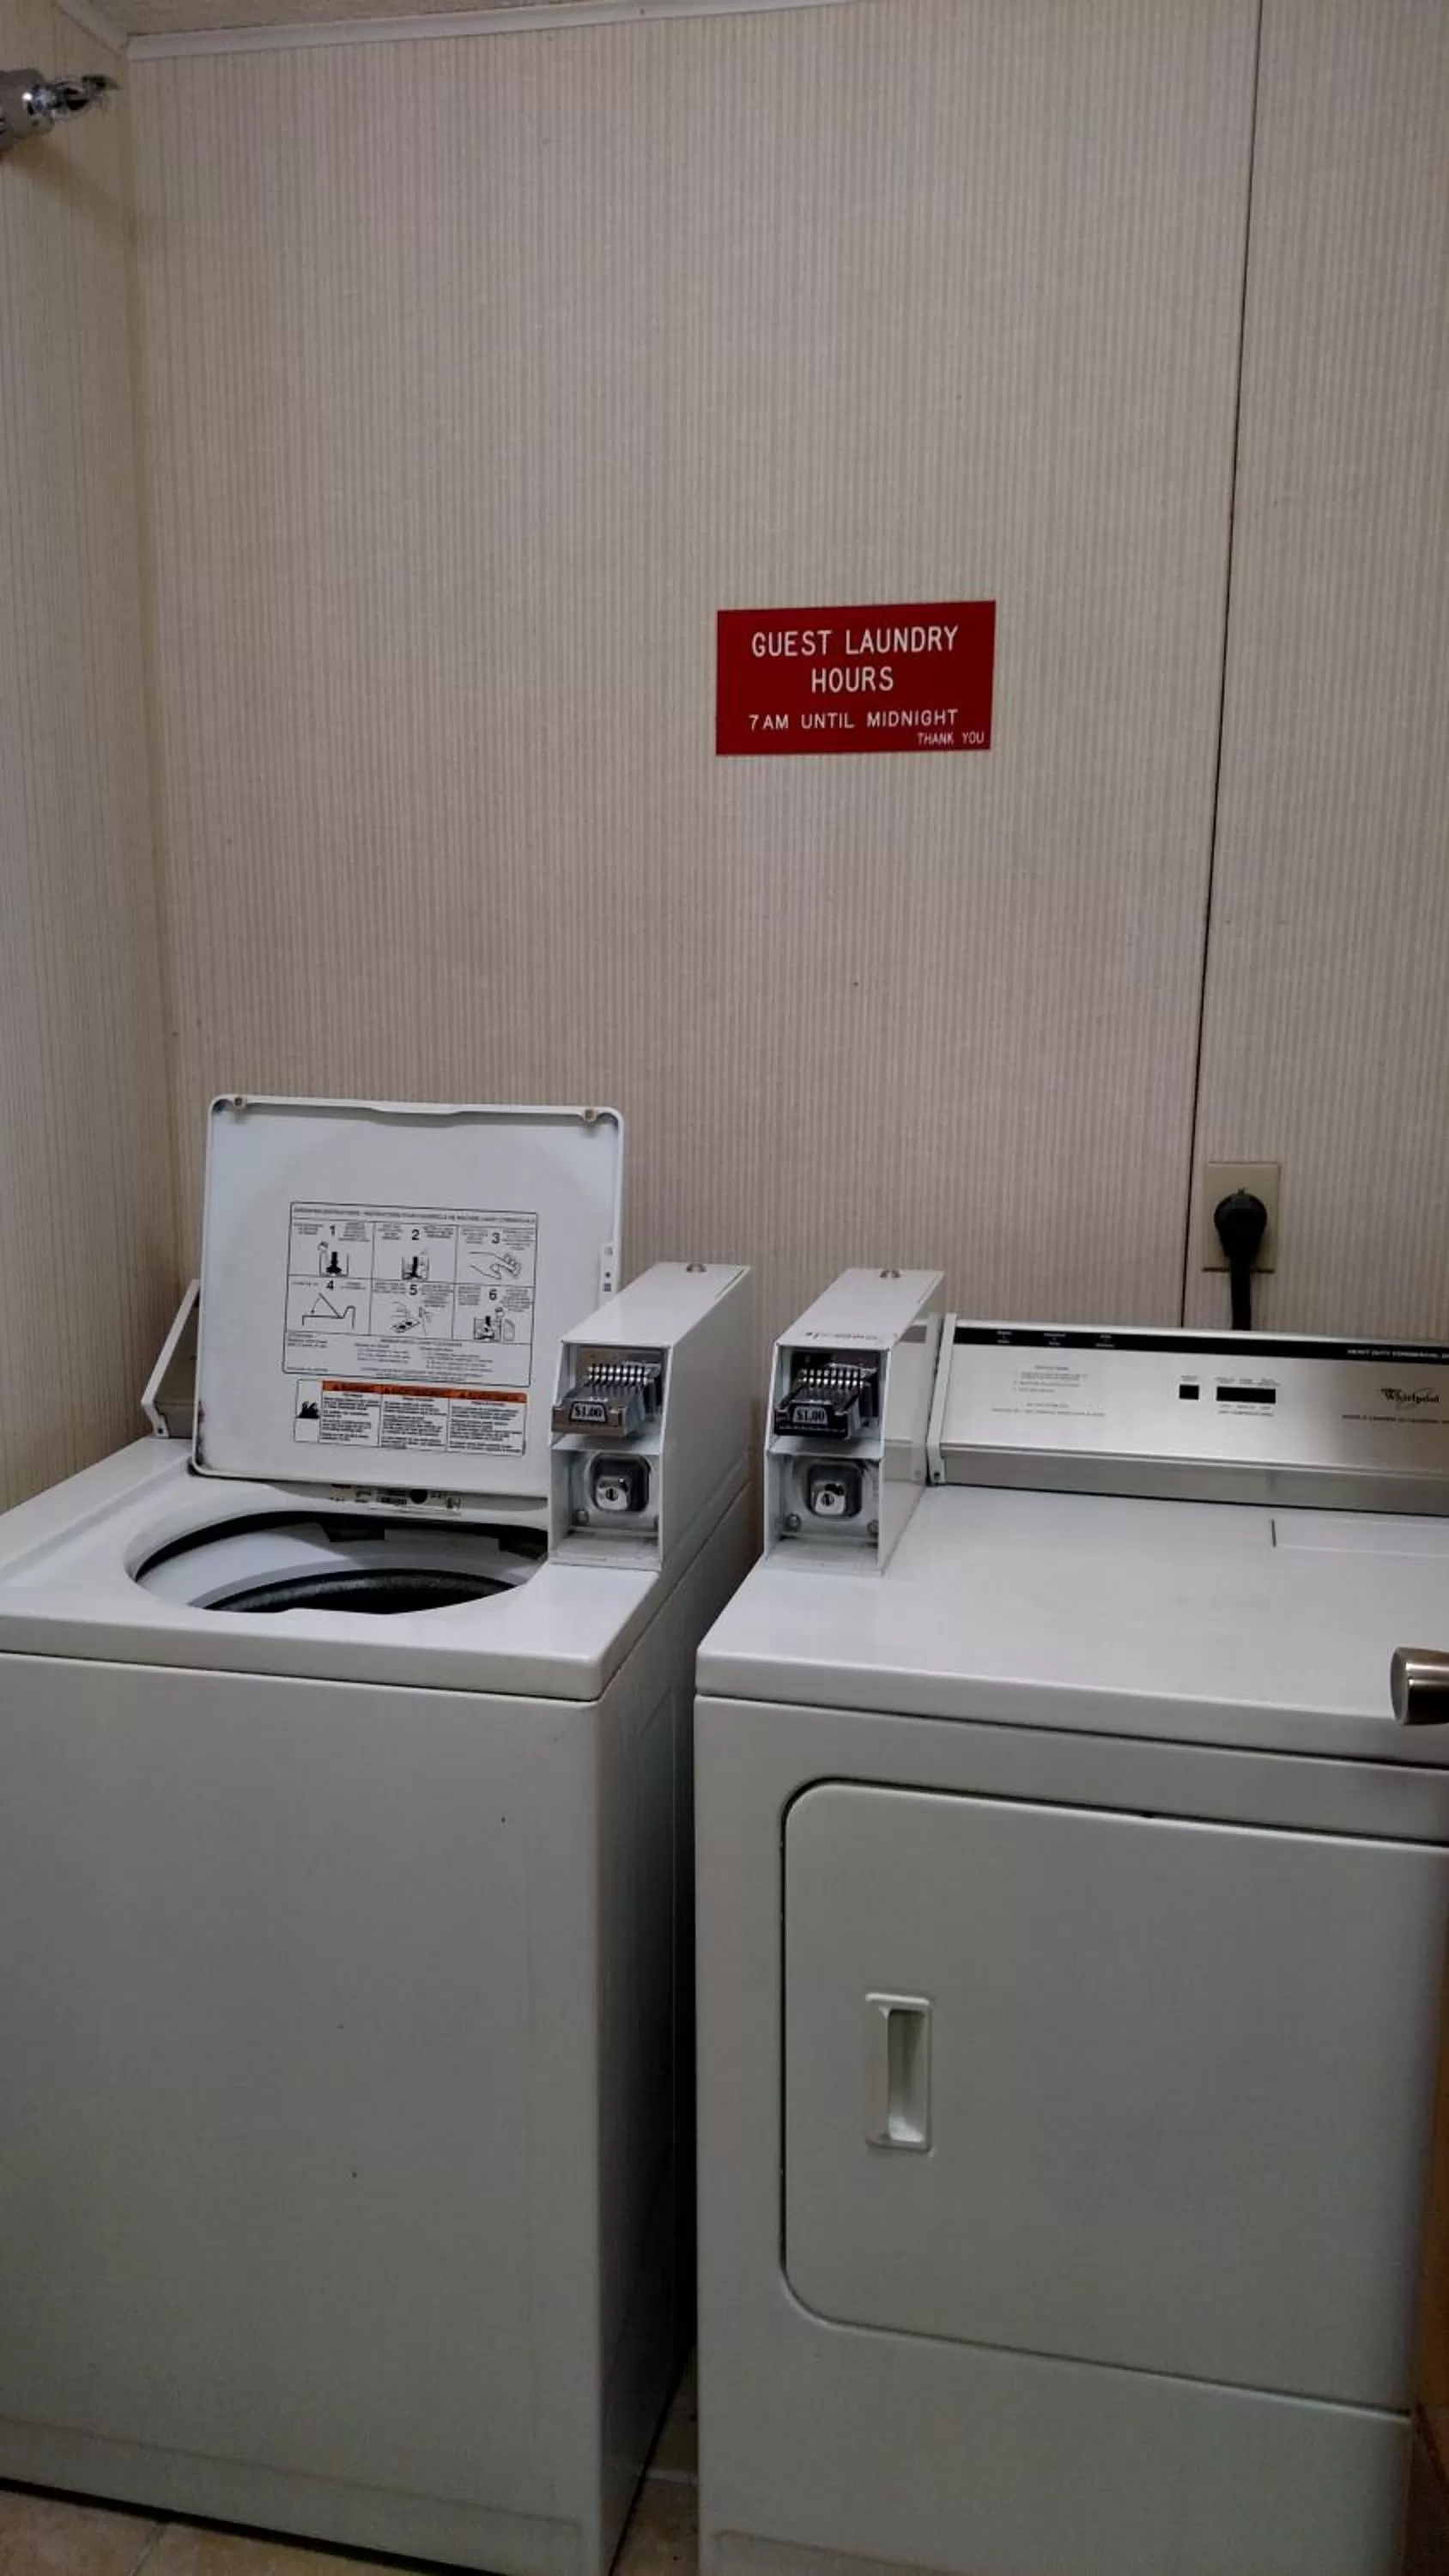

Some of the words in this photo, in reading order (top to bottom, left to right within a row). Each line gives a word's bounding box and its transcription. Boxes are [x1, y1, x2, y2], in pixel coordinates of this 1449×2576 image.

[752, 630, 832, 657] GUEST
[846, 625, 959, 655] LAUNDRY
[811, 666, 894, 693] HOURS
[749, 714, 789, 730] 7AM
[801, 712, 855, 729] UNTIL
[867, 709, 959, 727] MIDNIGHT
[917, 732, 954, 745] THANK
[962, 732, 985, 744] YOU
[330, 1224, 336, 1236] 1
[411, 1229, 420, 1241] 2
[491, 1232, 500, 1244] 3
[325, 1279, 334, 1291] 4
[409, 1284, 418, 1296] 5
[488, 1288, 498, 1301] 6
